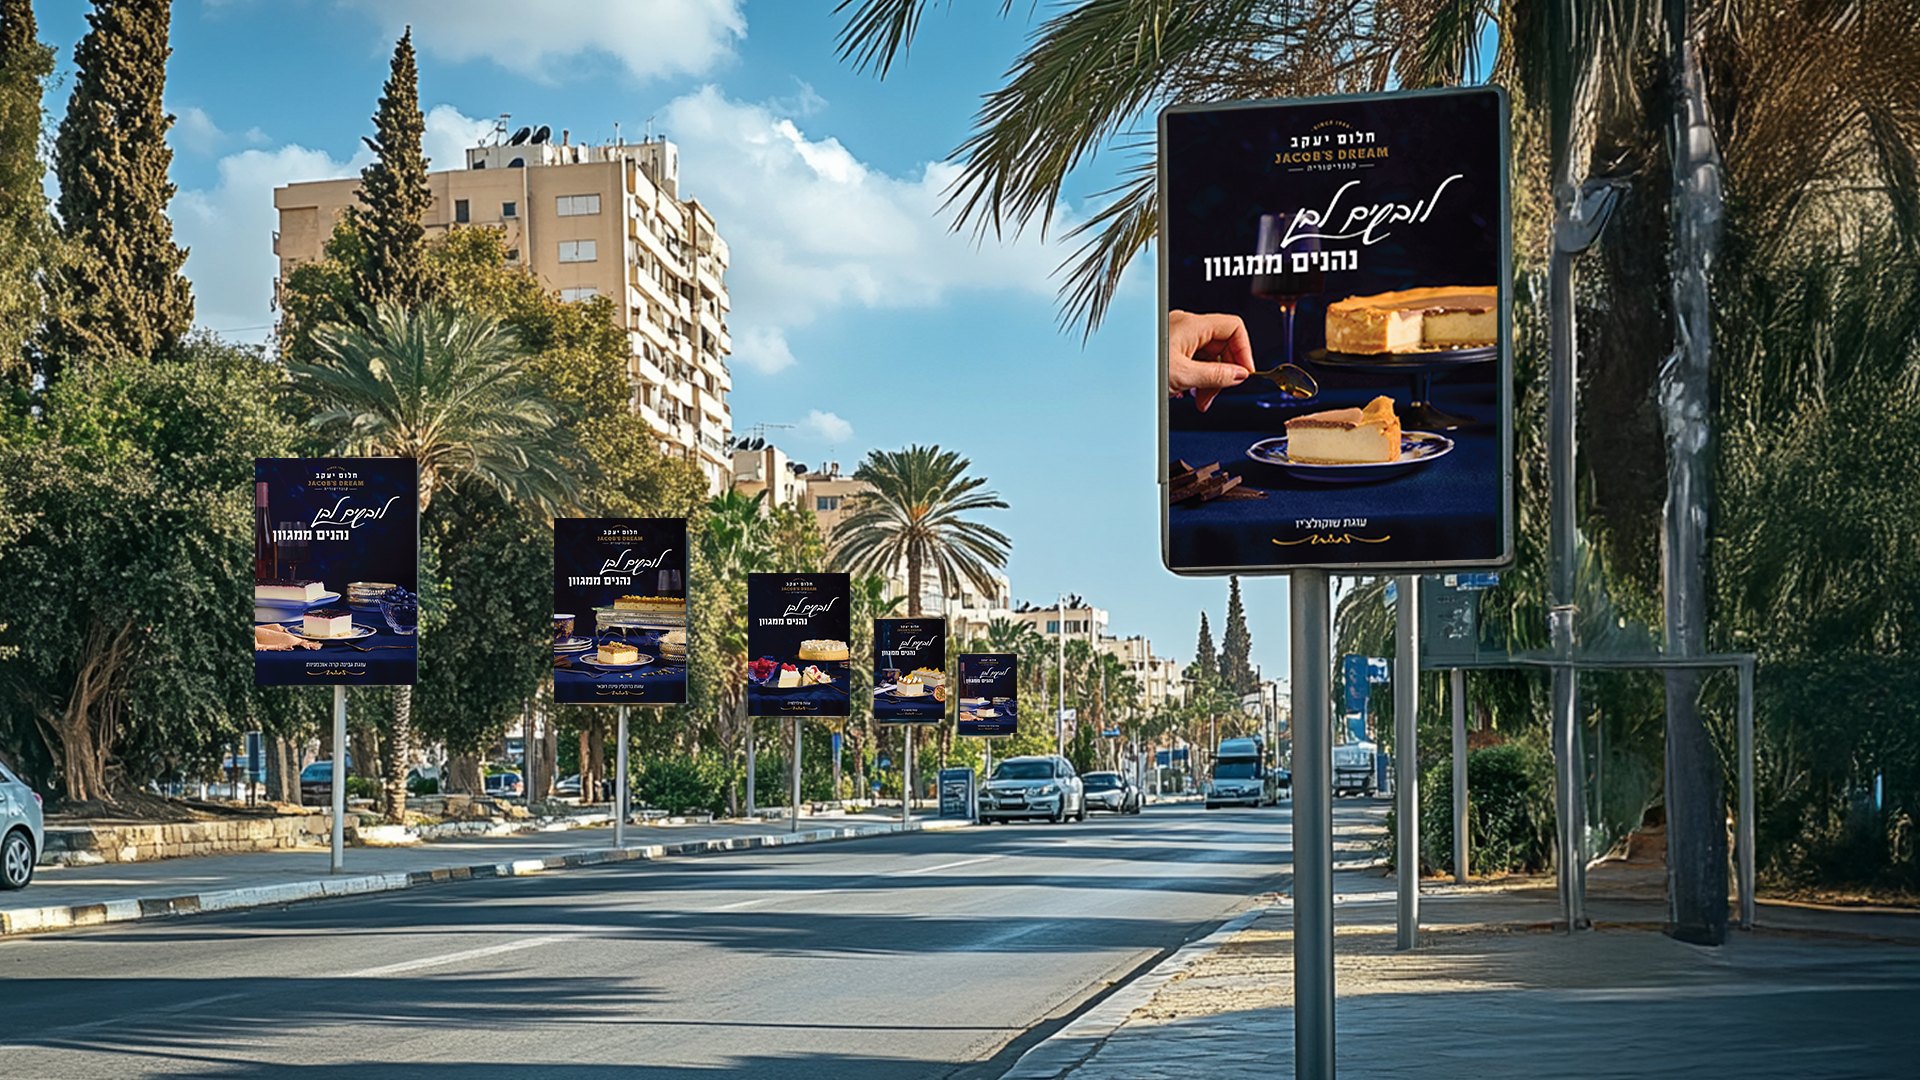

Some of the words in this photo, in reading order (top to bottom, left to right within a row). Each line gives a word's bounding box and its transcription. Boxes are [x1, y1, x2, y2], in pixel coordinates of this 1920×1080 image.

[1290, 135, 1330, 149] יעקב
[1337, 131, 1376, 145] חלום
[1274, 150, 1334, 164] JACOB'S
[1338, 146, 1389, 160] DREAM
[1280, 180, 1361, 249] לבן
[1339, 174, 1464, 246] לובשים
[1203, 253, 1283, 282] ממגוון
[1291, 250, 1358, 273] נהנים
[315, 472, 336, 480] יעקב
[310, 496, 350, 528] לבן
[339, 496, 400, 529] לובשים
[1343, 518, 1368, 528] עוגת
[272, 529, 313, 543] ממגוון
[316, 529, 349, 541] נהנים
[599, 548, 632, 575] לבן
[623, 548, 673, 576] לובשים
[568, 576, 601, 587] ממגוון
[603, 576, 631, 585] נהנים
[782, 597, 808, 618] לבן
[801, 597, 840, 618] לובשים
[759, 618, 784, 627] ממגוון
